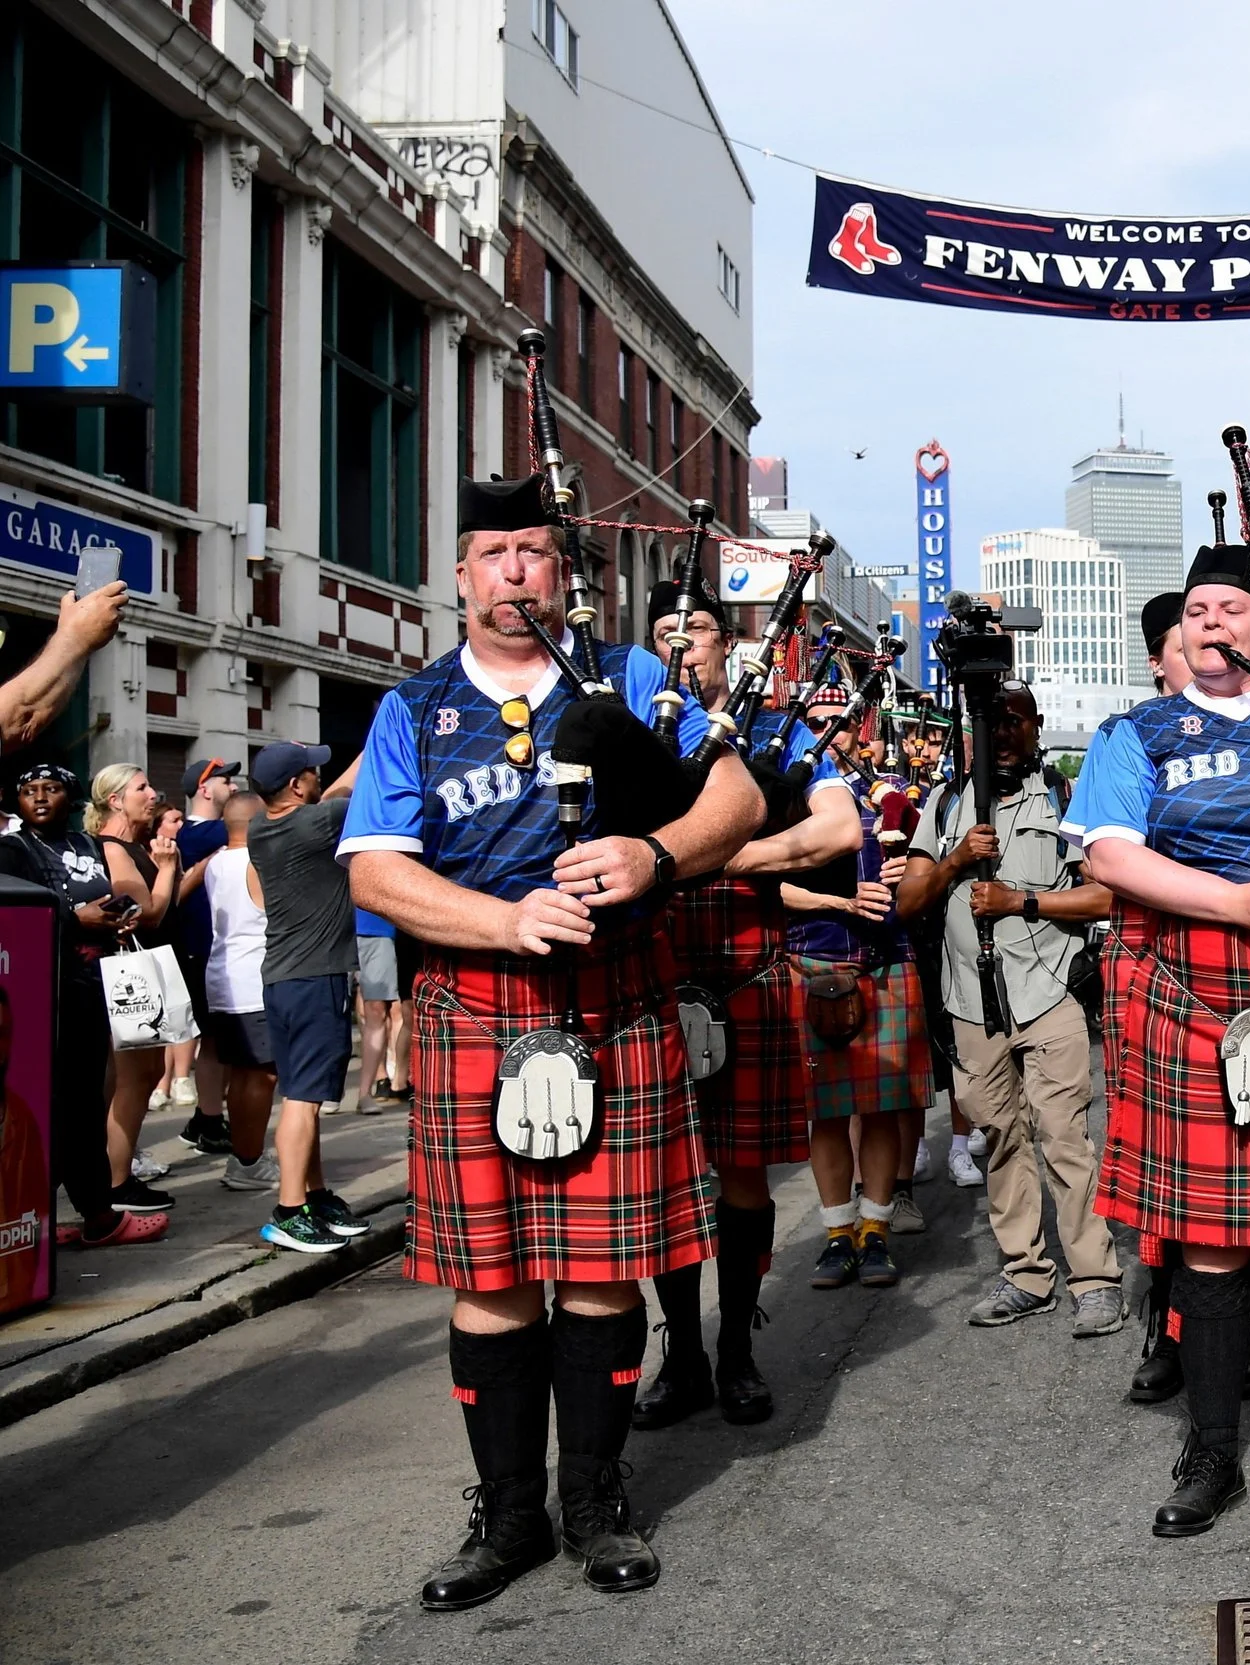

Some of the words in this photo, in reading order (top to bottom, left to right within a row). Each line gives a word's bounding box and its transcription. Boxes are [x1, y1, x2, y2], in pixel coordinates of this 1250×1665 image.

[1065, 223, 1203, 244] WELCOME
[923, 235, 1196, 292] FENWAY
[1109, 303, 1180, 320] GATE
[1194, 303, 1211, 319] C
[9, 283, 79, 373] P
[922, 488, 945, 604] HOUSE
[865, 566, 905, 576] Citizens
[434, 708, 460, 736] B
[1178, 715, 1204, 735] B
[1164, 749, 1241, 791] RED
[436, 761, 522, 823] RED
[109, 1004, 156, 1016] TAQUERIA
